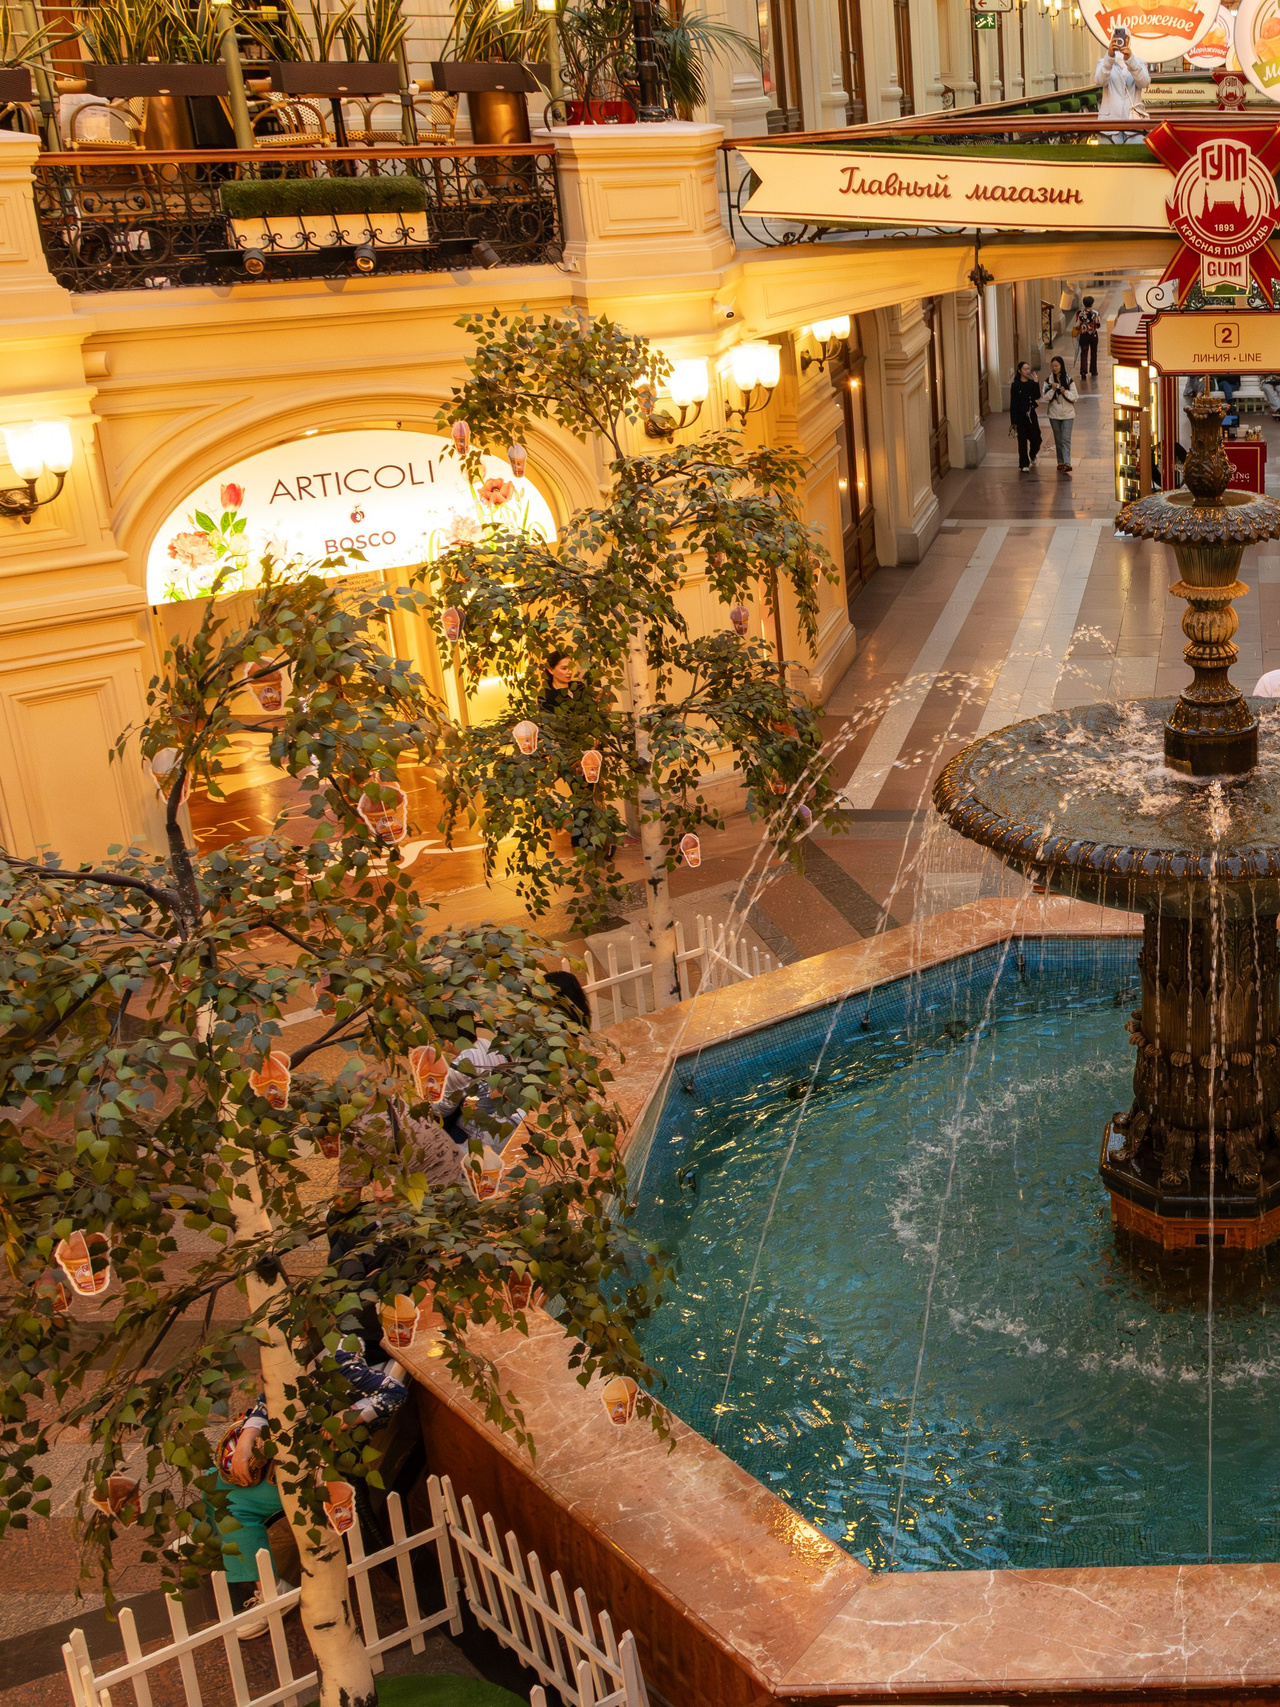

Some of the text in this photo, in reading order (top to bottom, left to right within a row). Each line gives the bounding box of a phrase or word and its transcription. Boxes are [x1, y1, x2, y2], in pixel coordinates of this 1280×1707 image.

[1107, 12, 1194, 33] Мороженое
[1201, 144, 1247, 182] ГУМ
[838, 166, 1084, 205] Главный магазин
[1180, 223, 1269, 255] КРАСНАЯ ПЛОЩАДЬ
[1214, 224, 1235, 232] 1893
[1207, 261, 1242, 277] GUM
[1221, 327, 1233, 344] 2
[1192, 352, 1262, 363] ЛИНИЯ LINE
[269, 460, 434, 505] ARTICOLI
[325, 531, 396, 555] BOSCO
